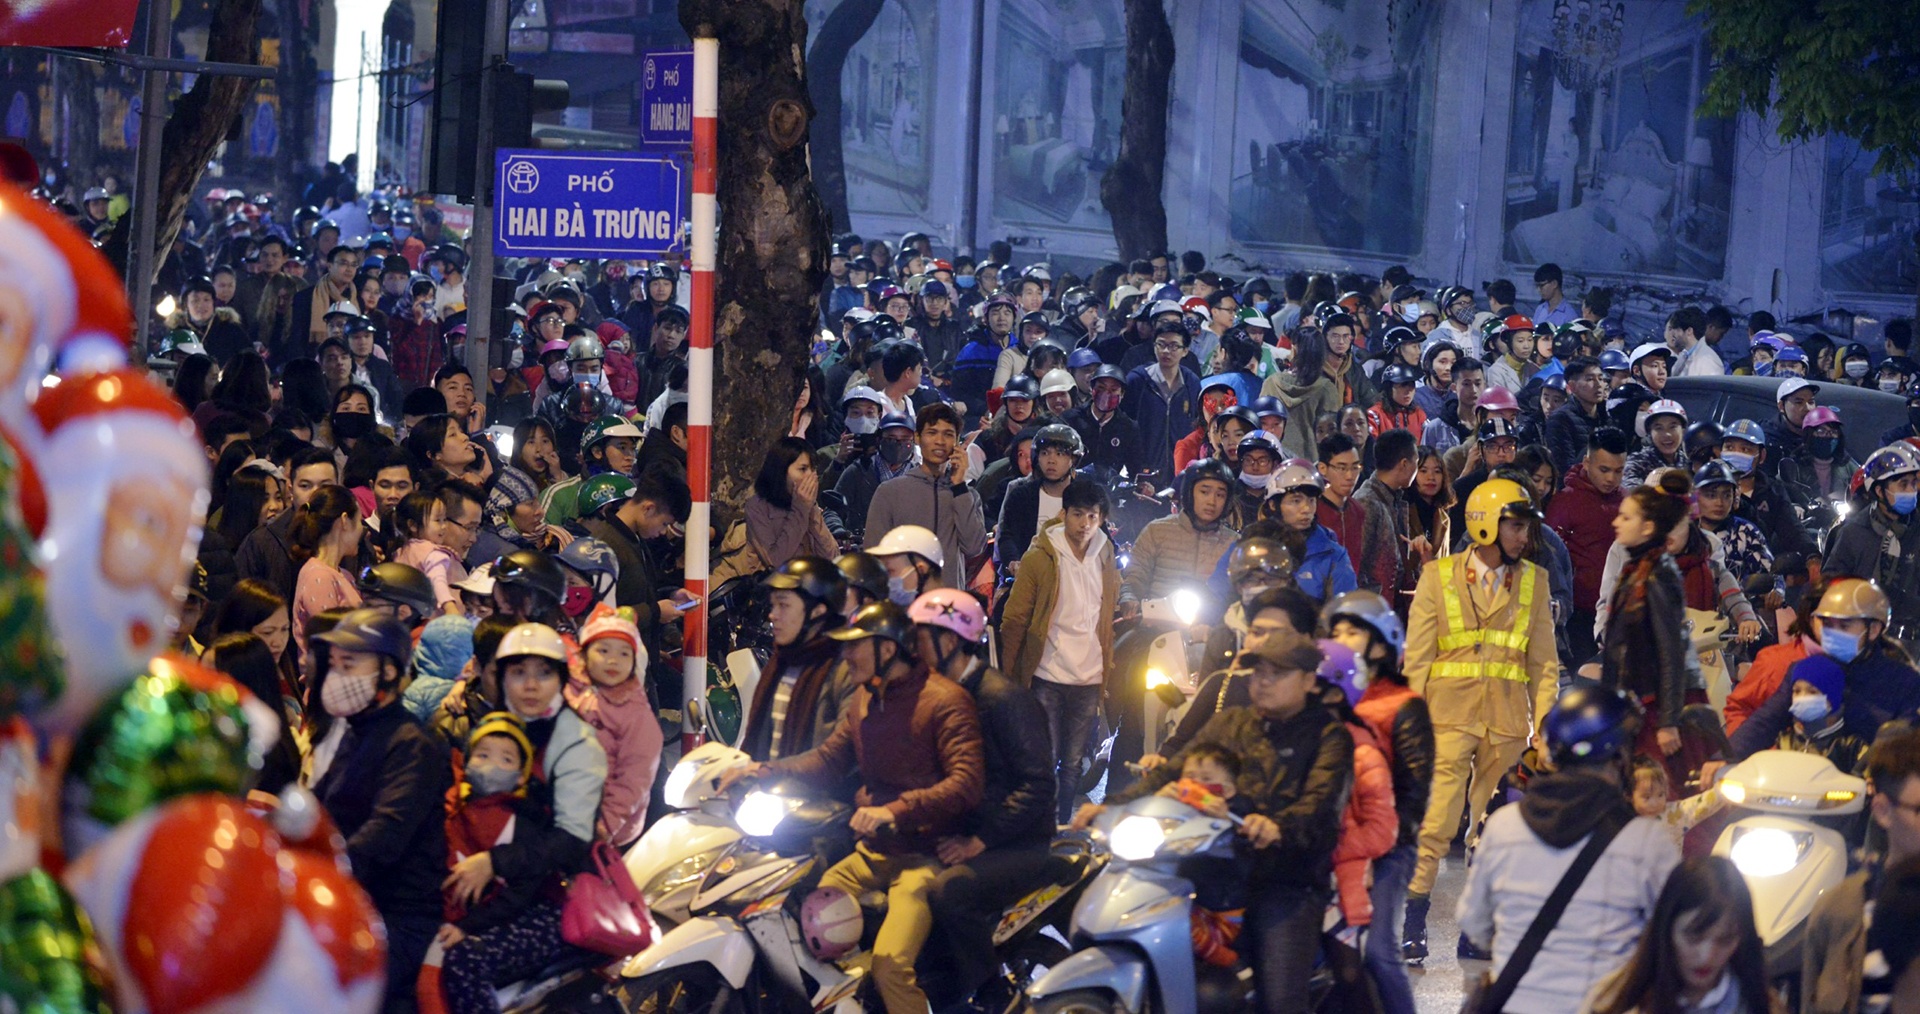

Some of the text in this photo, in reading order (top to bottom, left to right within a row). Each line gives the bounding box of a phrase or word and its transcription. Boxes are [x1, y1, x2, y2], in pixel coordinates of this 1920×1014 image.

[664, 64, 680, 86] PHỐ
[650, 97, 691, 131] HÀNG BÀI
[568, 169, 615, 193] PHỐ
[508, 207, 547, 236] HAI
[554, 202, 586, 238] BÀ
[593, 207, 671, 240] TRƯNG
[591, 484, 616, 500] Grab
